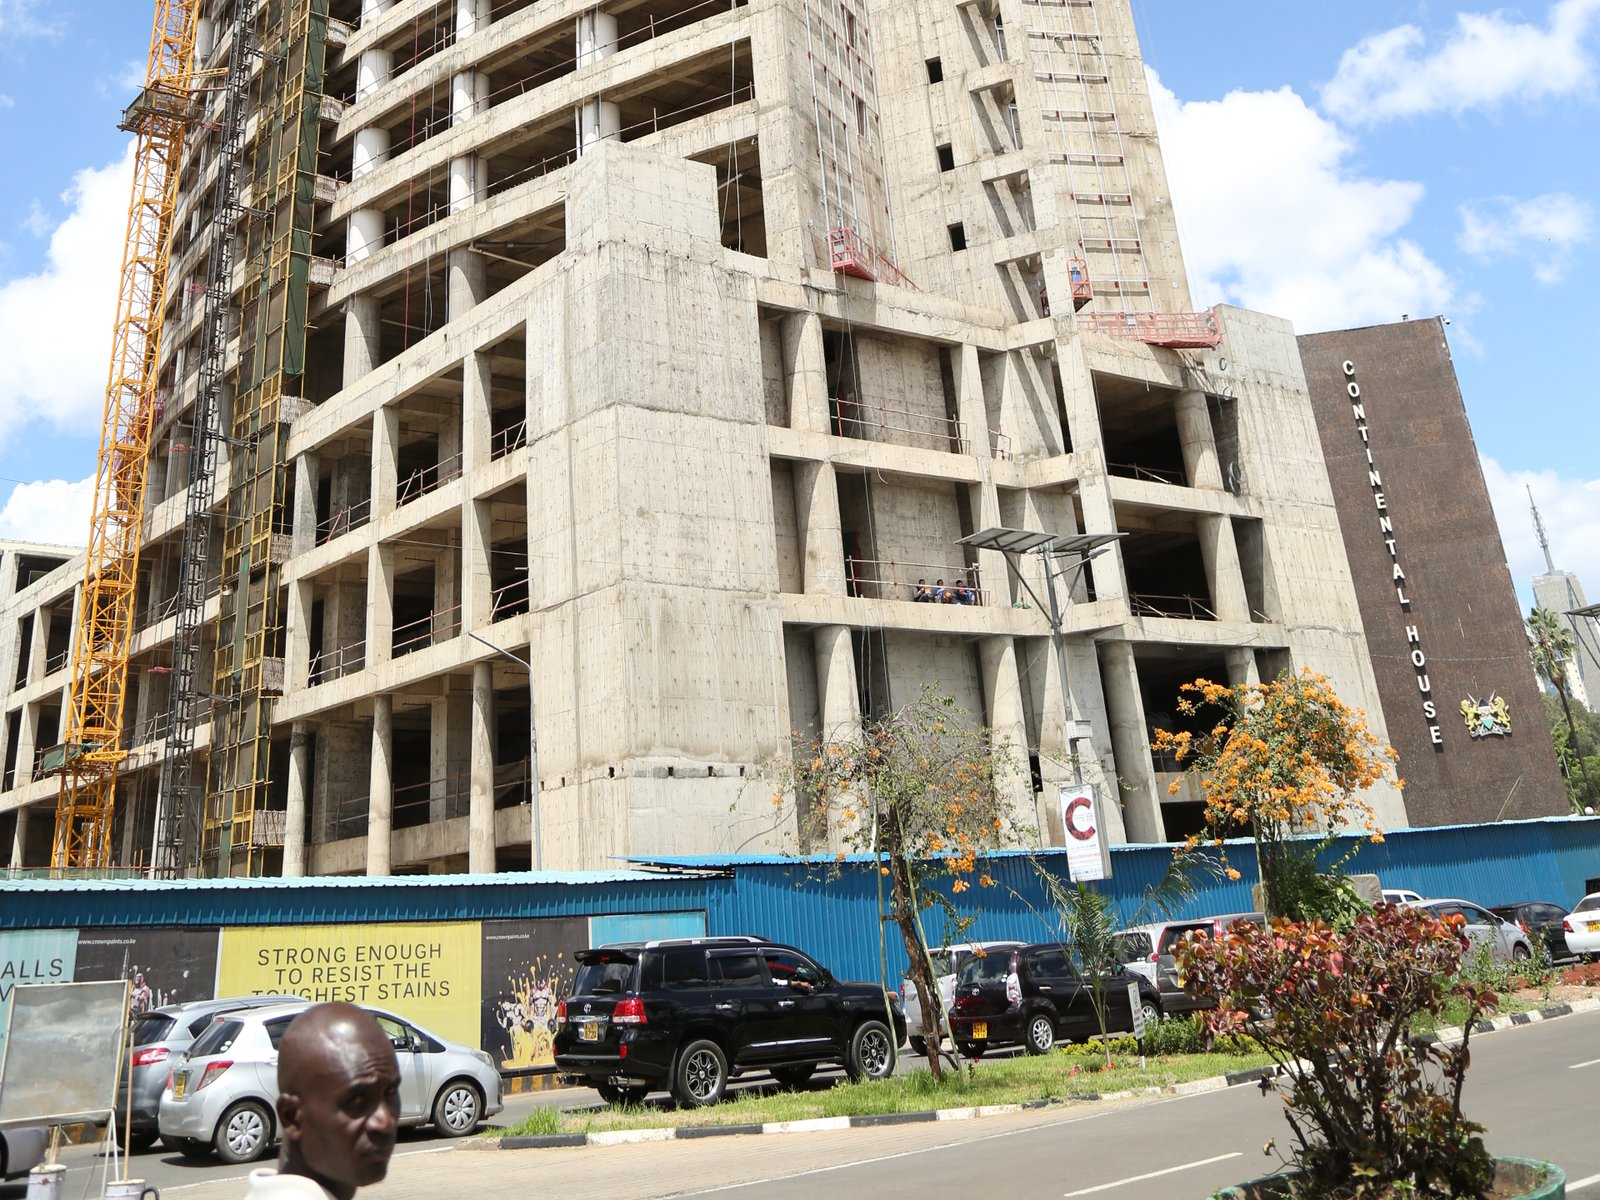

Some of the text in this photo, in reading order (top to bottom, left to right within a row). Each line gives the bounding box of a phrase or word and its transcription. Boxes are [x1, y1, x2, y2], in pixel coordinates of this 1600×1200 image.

[1342, 360, 1443, 744] CONTINENTAL HOUSE
[1065, 797, 1096, 840] C
[258, 944, 441, 965] STRONG ENOUGH
[275, 962, 431, 985] TO RESIST THE
[378, 981, 450, 1000] STAINS
